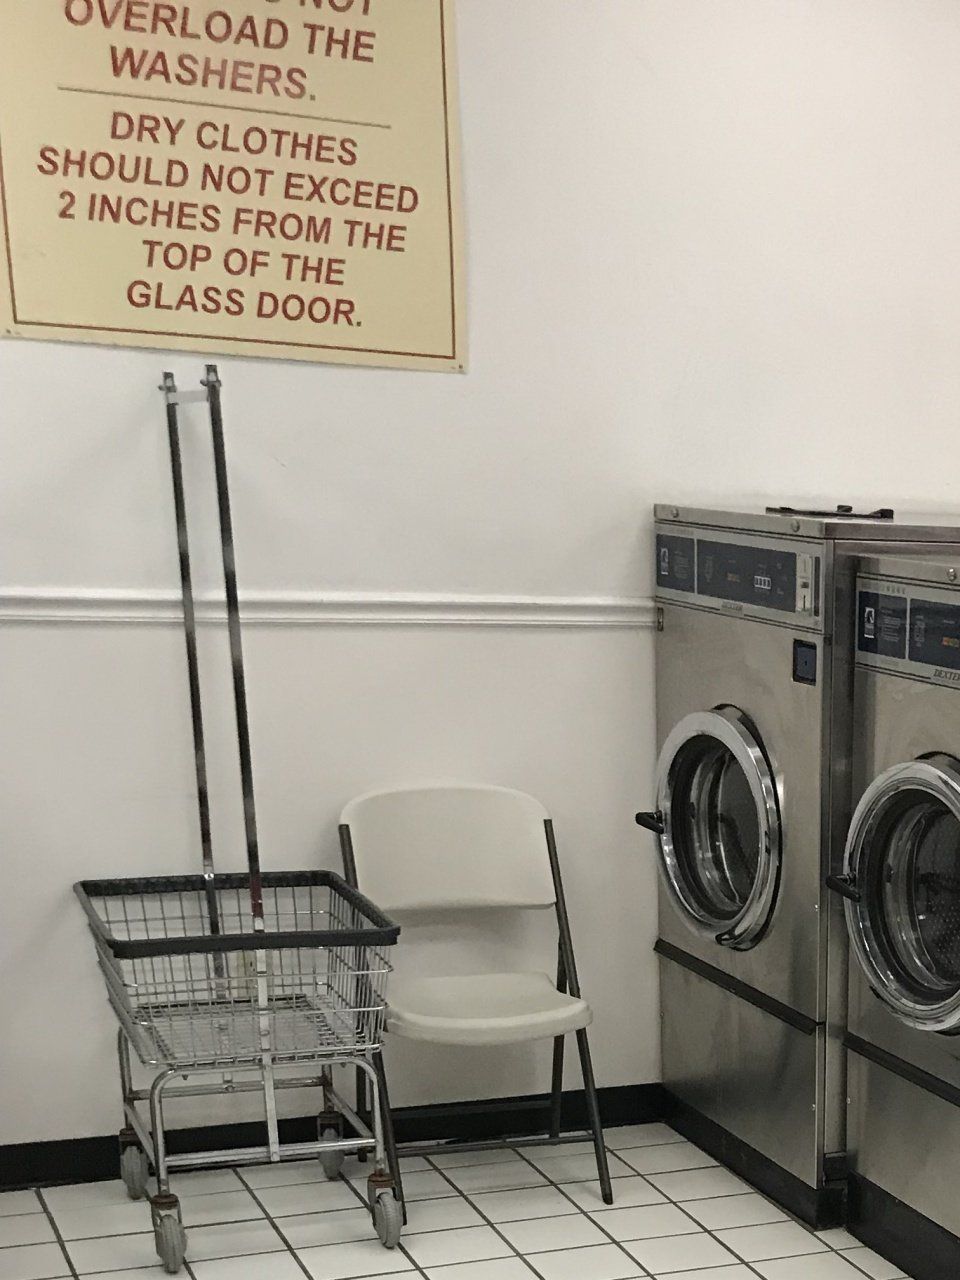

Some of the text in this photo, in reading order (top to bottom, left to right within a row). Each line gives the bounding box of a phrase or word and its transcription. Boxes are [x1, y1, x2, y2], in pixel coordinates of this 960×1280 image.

[65, 0, 377, 63] OVERLOAD THE
[110, 45, 316, 101] WASHERS.
[110, 111, 358, 166] DRY CLOTHES
[36, 146, 419, 214] SHOULD NOT EXCEED
[57, 190, 408, 253] 2 INCHES FROM THE
[142, 240, 346, 286] TOP OF THE
[126, 280, 362, 328] GLASS DOOR.
